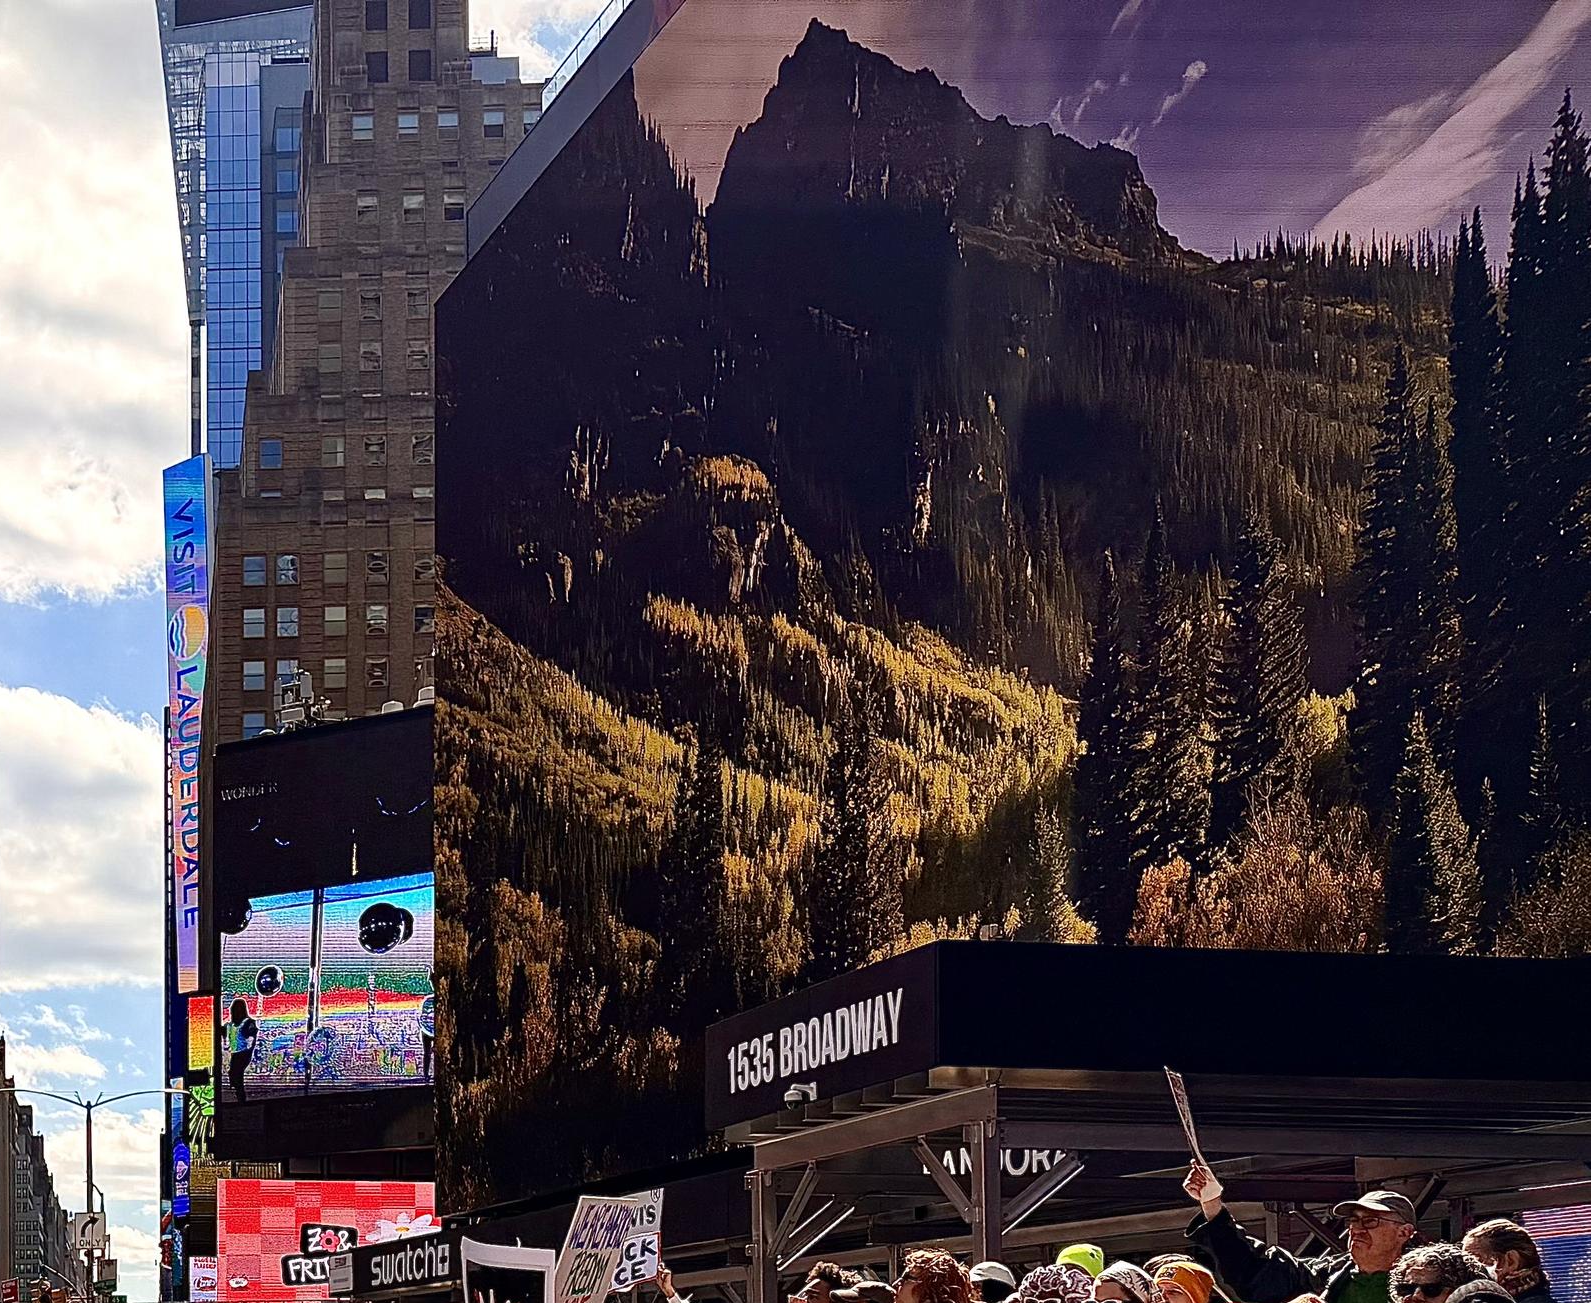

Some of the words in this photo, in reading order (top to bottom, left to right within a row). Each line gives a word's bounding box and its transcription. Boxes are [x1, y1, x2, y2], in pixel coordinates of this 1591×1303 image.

[171, 498, 195, 594] VISIT
[176, 665, 200, 929] LAUDERDALE
[727, 1032, 775, 1094] 1535
[779, 987, 903, 1078] BROADWAY
